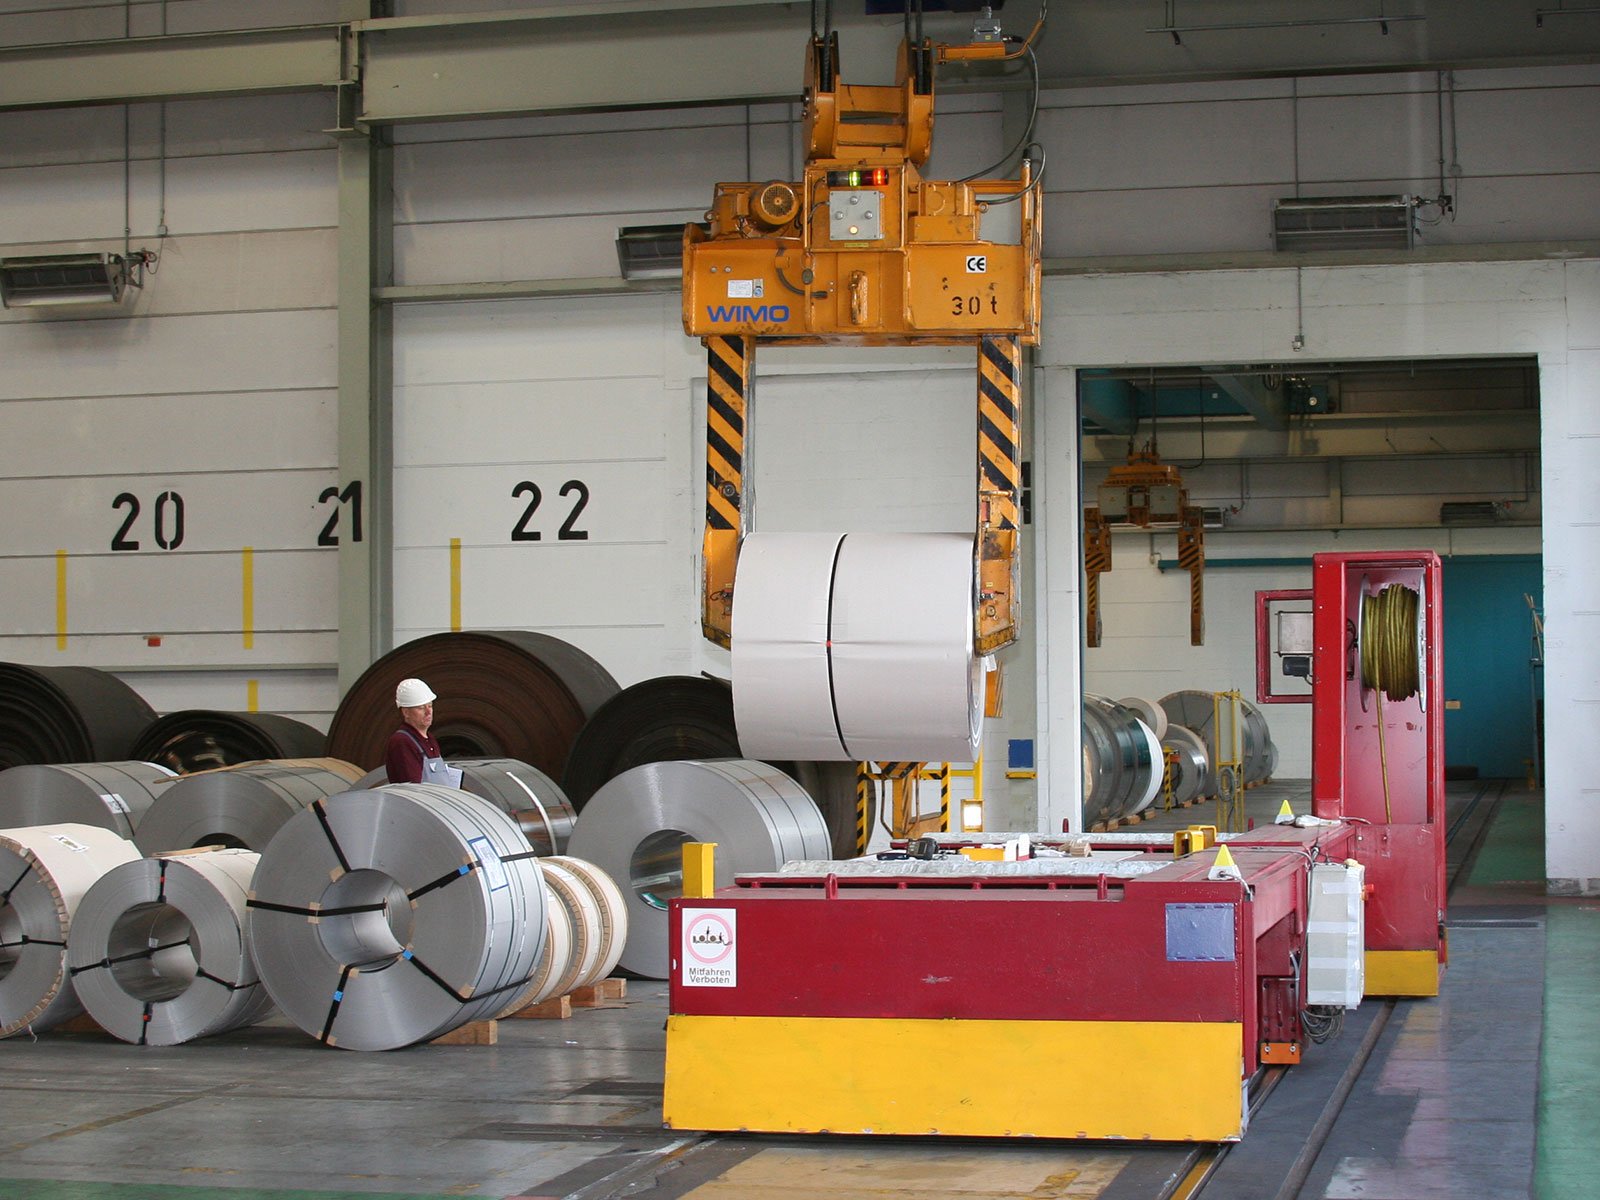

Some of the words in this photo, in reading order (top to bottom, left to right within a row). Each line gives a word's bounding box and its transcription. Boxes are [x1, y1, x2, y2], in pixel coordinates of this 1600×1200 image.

[967, 257, 986, 272] CE
[707, 305, 789, 322] WIMO
[952, 296, 980, 315] 30
[990, 297, 999, 315] t
[317, 480, 363, 547] 21
[511, 479, 590, 542] 22
[111, 490, 185, 552] 20
[689, 967, 731, 976] Mitfahren
[690, 975, 730, 984] Verboten
